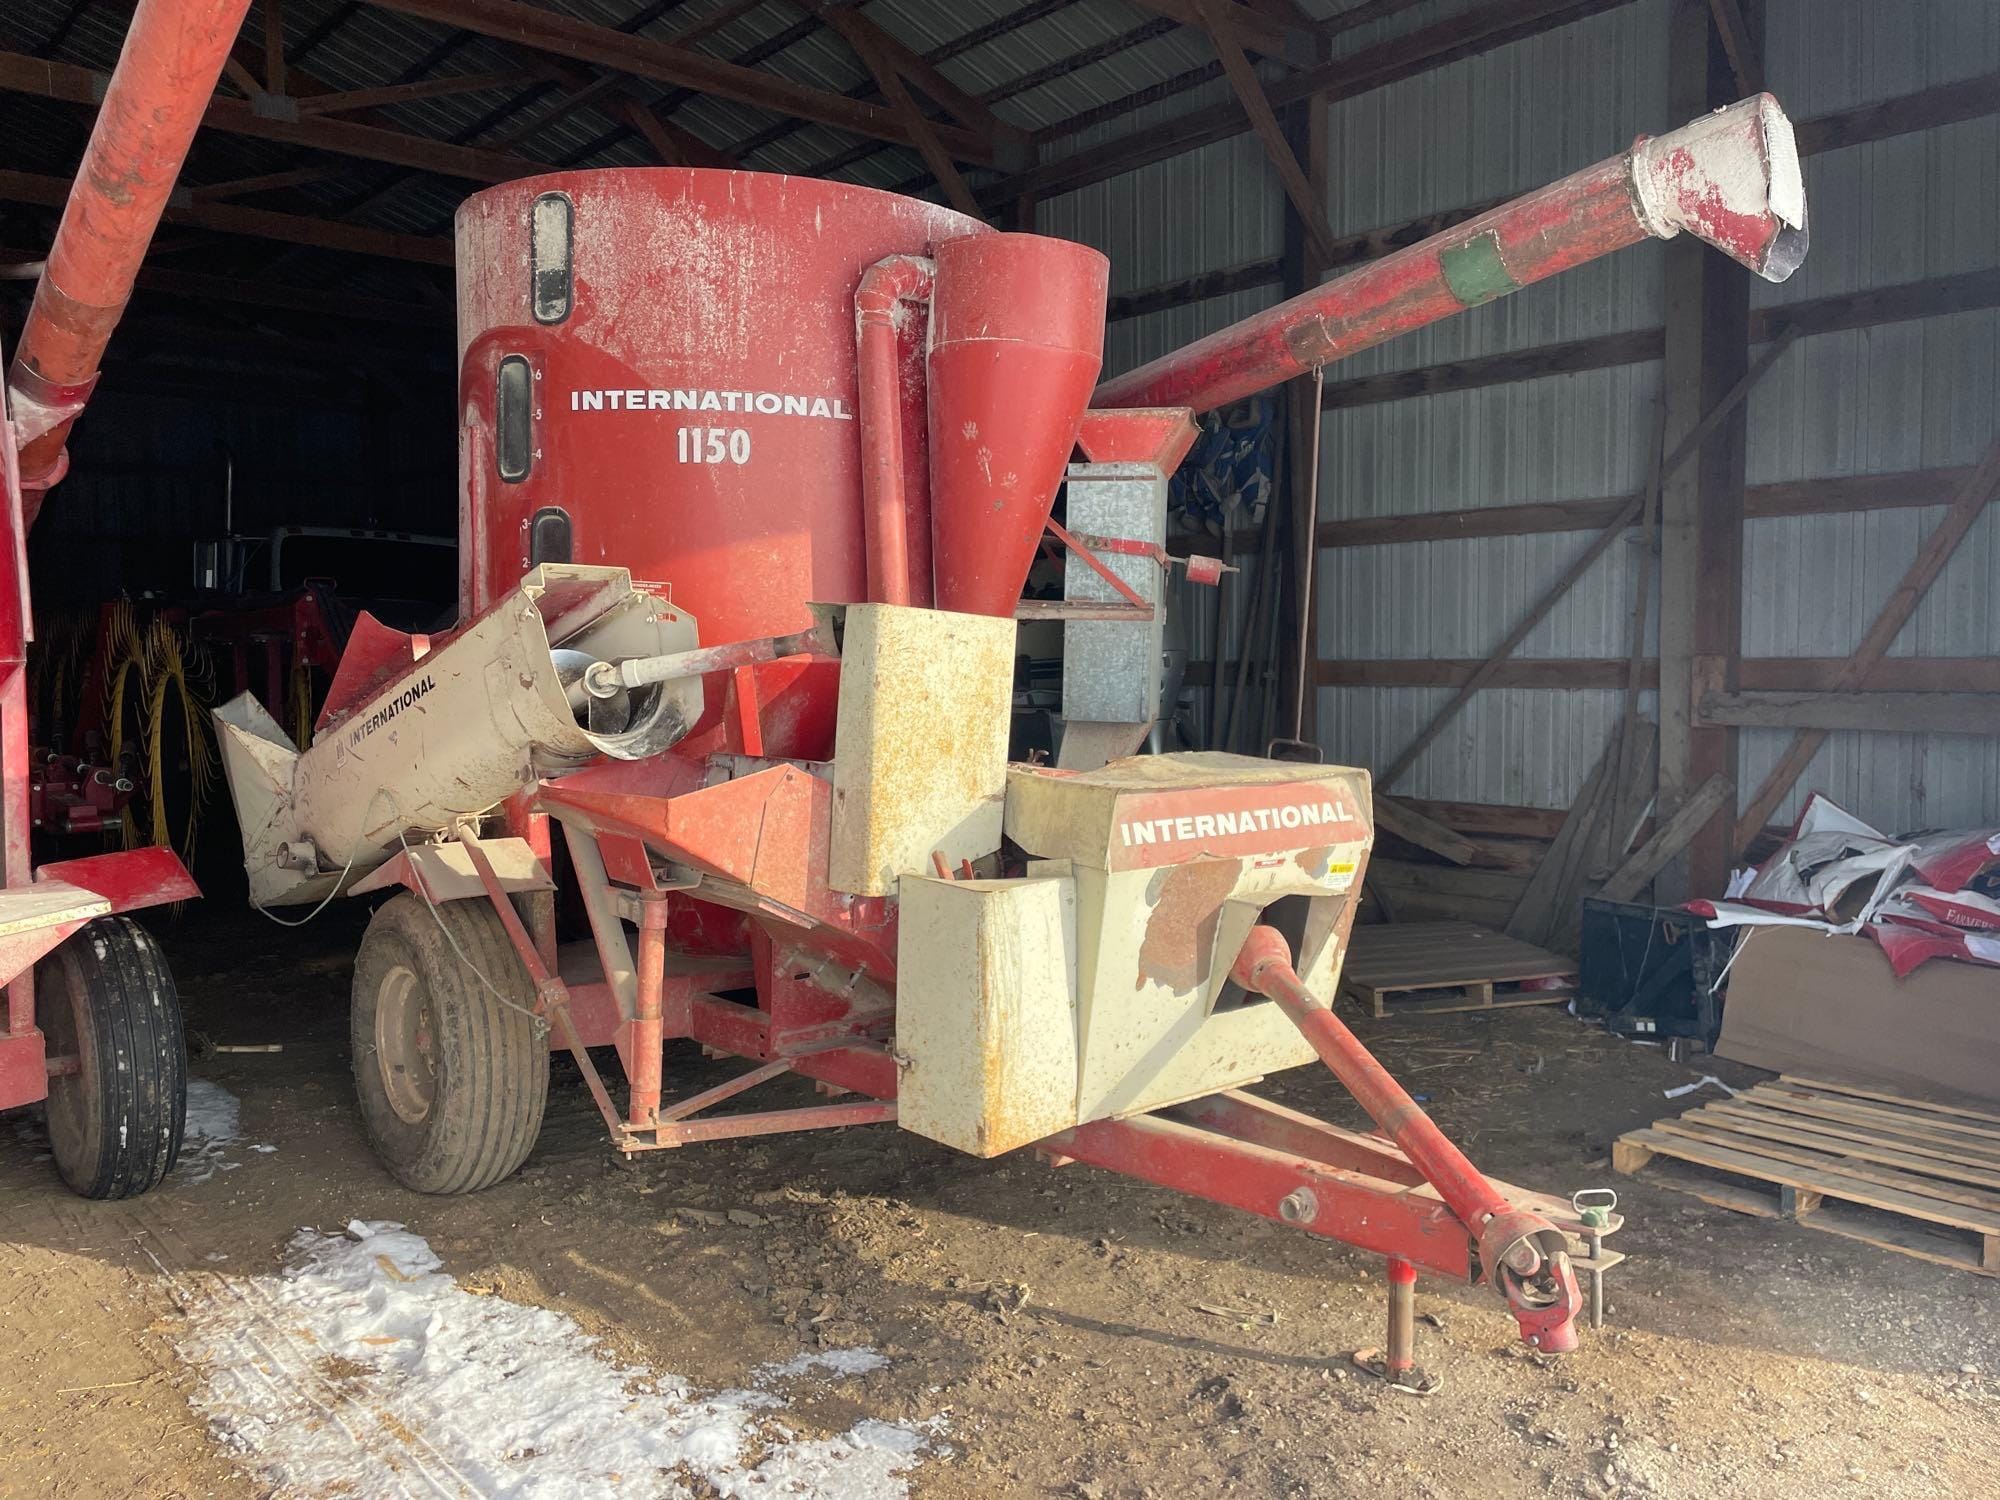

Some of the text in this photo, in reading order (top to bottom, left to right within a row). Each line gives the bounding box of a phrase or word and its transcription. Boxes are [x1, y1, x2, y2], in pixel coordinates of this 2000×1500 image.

[521, 254, 528, 266] 8
[521, 294, 529, 306] 7
[535, 369, 542, 380] 6
[571, 390, 853, 420] INTERNATIONAL
[535, 408, 543, 420] 5
[677, 427, 751, 465] 1150
[535, 448, 543, 460] 4
[522, 518, 529, 529] 3
[522, 557, 529, 568] 2
[349, 675, 436, 748] INTERNATIONAL
[1120, 802, 1353, 845] INTERNATIONAL
